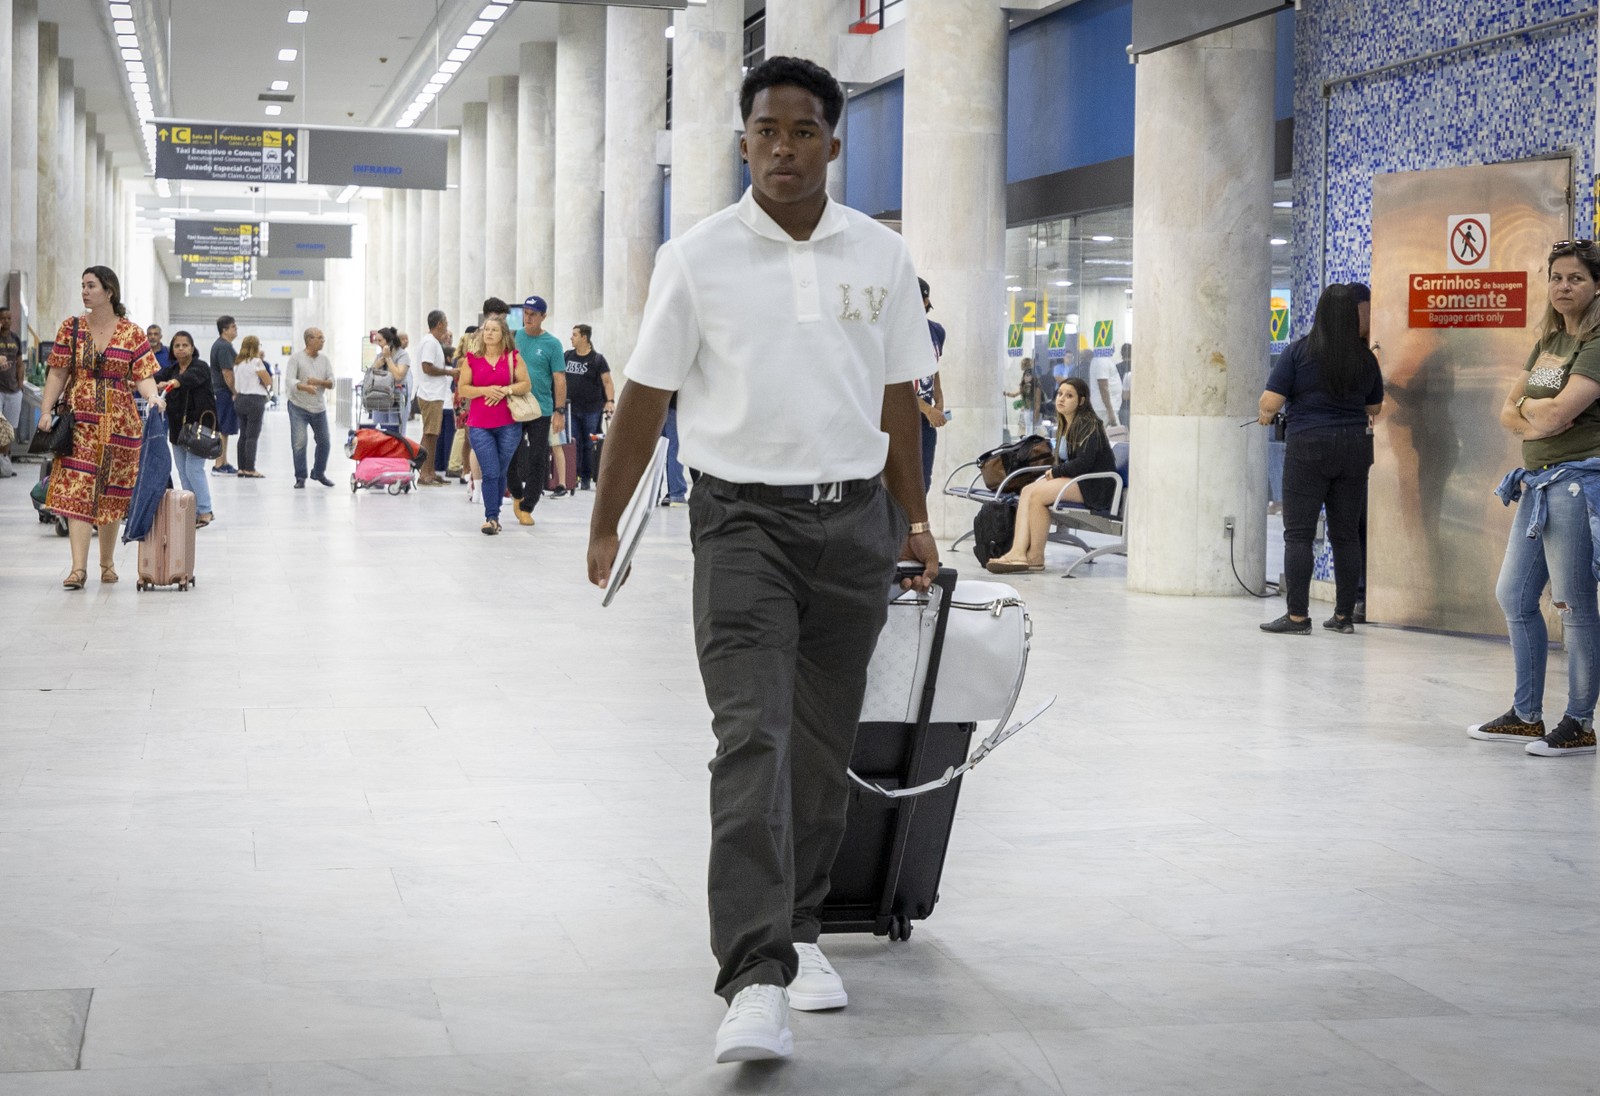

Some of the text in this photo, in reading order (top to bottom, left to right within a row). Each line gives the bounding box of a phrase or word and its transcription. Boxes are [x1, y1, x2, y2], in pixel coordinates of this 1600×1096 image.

[176, 129, 187, 142] C
[191, 148, 226, 156] Executivo
[234, 149, 262, 157] Comum
[185, 163, 212, 172] Juizado
[213, 164, 243, 173] Especial
[1413, 275, 1481, 291] Carrinhos
[1492, 282, 1523, 291] bagagem
[1427, 291, 1507, 308] somente
[1023, 301, 1036, 323] 2
[1428, 312, 1504, 324] Baggage carts only
